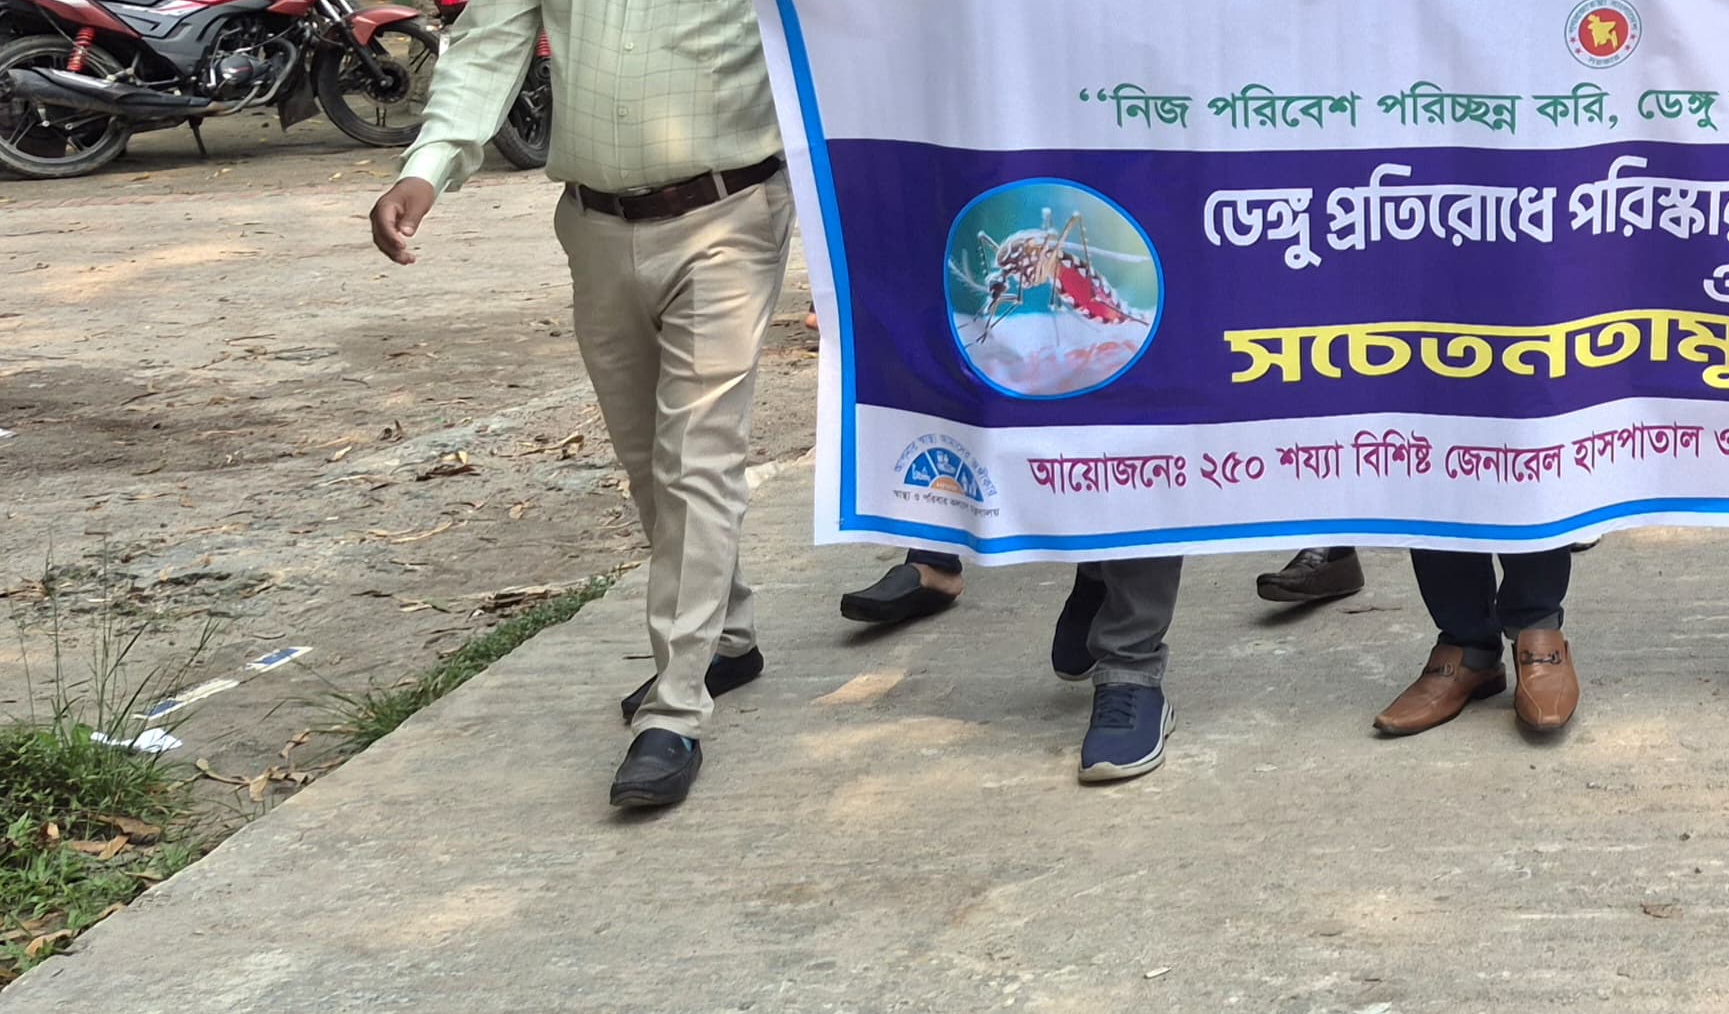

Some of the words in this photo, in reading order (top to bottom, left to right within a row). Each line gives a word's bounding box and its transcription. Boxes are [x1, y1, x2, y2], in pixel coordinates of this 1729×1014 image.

[1206, 82, 1362, 130] পরিবেশ
[1376, 80, 1522, 136] পরিচ্ছন্ন
[1532, 81, 1618, 130] করি,
[1636, 86, 1720, 132] ডেঙ্গু
[1202, 186, 1322, 271] ডেঙ্গু
[1325, 162, 1558, 251] প্রতিরোধে
[1198, 450, 1266, 490] ২৫০
[1275, 439, 1344, 481] শয্যা
[1350, 428, 1434, 480] বিশিষ্ট
[1444, 442, 1566, 484] জেনারেল
[1571, 420, 1706, 475] হাসপাতাল
